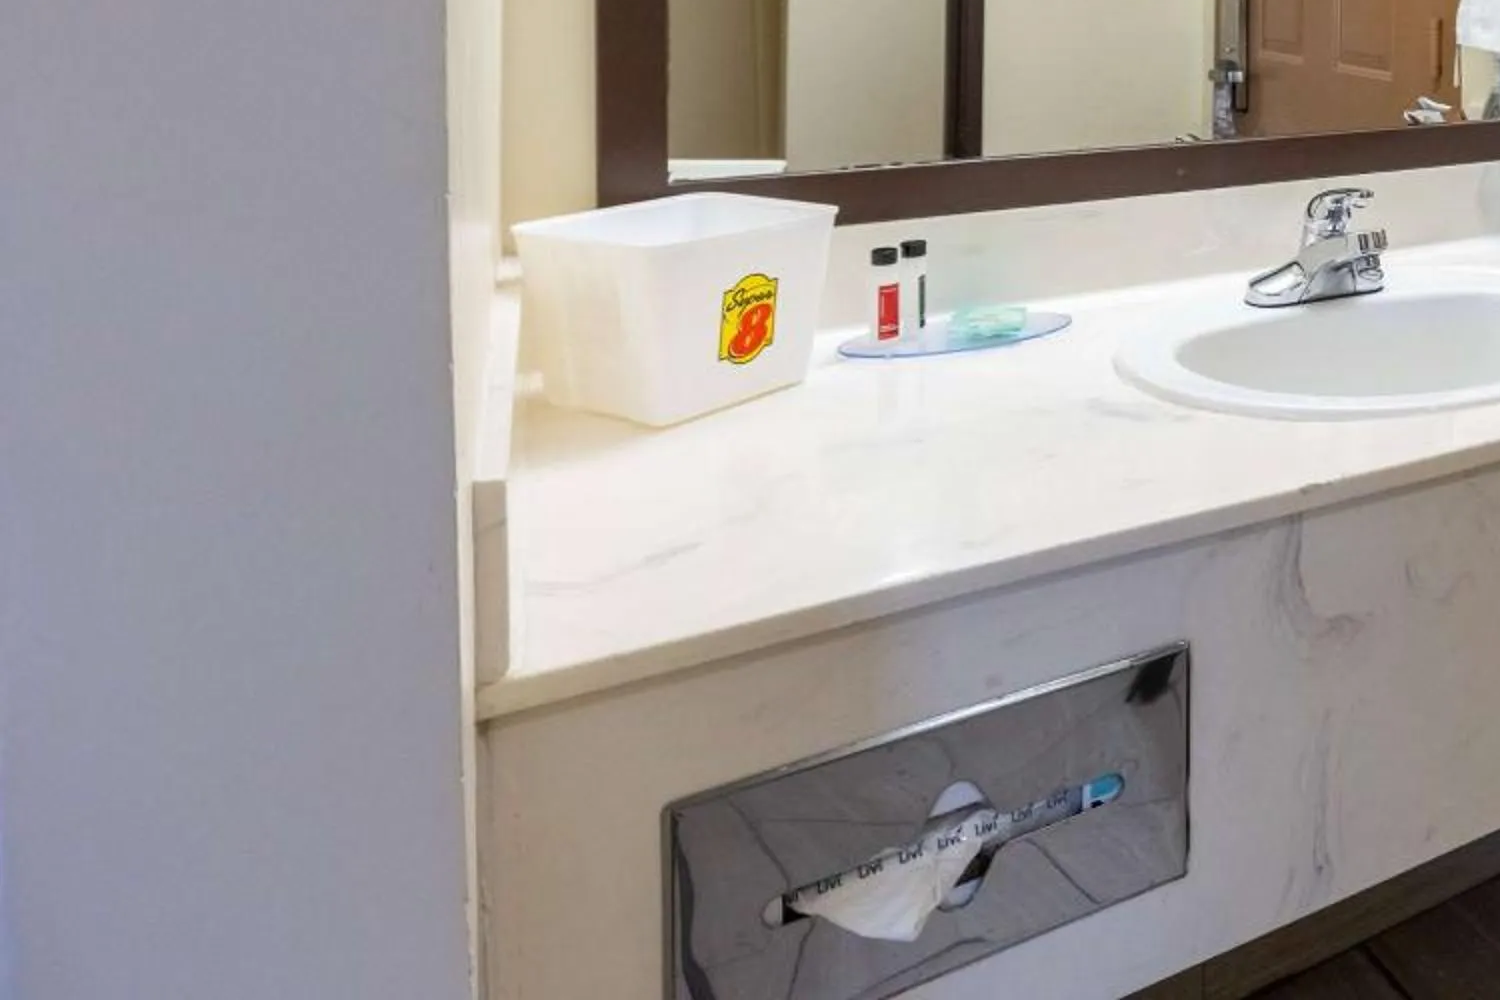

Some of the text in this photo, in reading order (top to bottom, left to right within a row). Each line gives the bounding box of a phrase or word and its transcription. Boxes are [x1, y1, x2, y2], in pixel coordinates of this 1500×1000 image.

[725, 287, 773, 313] Super
[727, 303, 772, 358] 8
[974, 812, 999, 836] Livi
